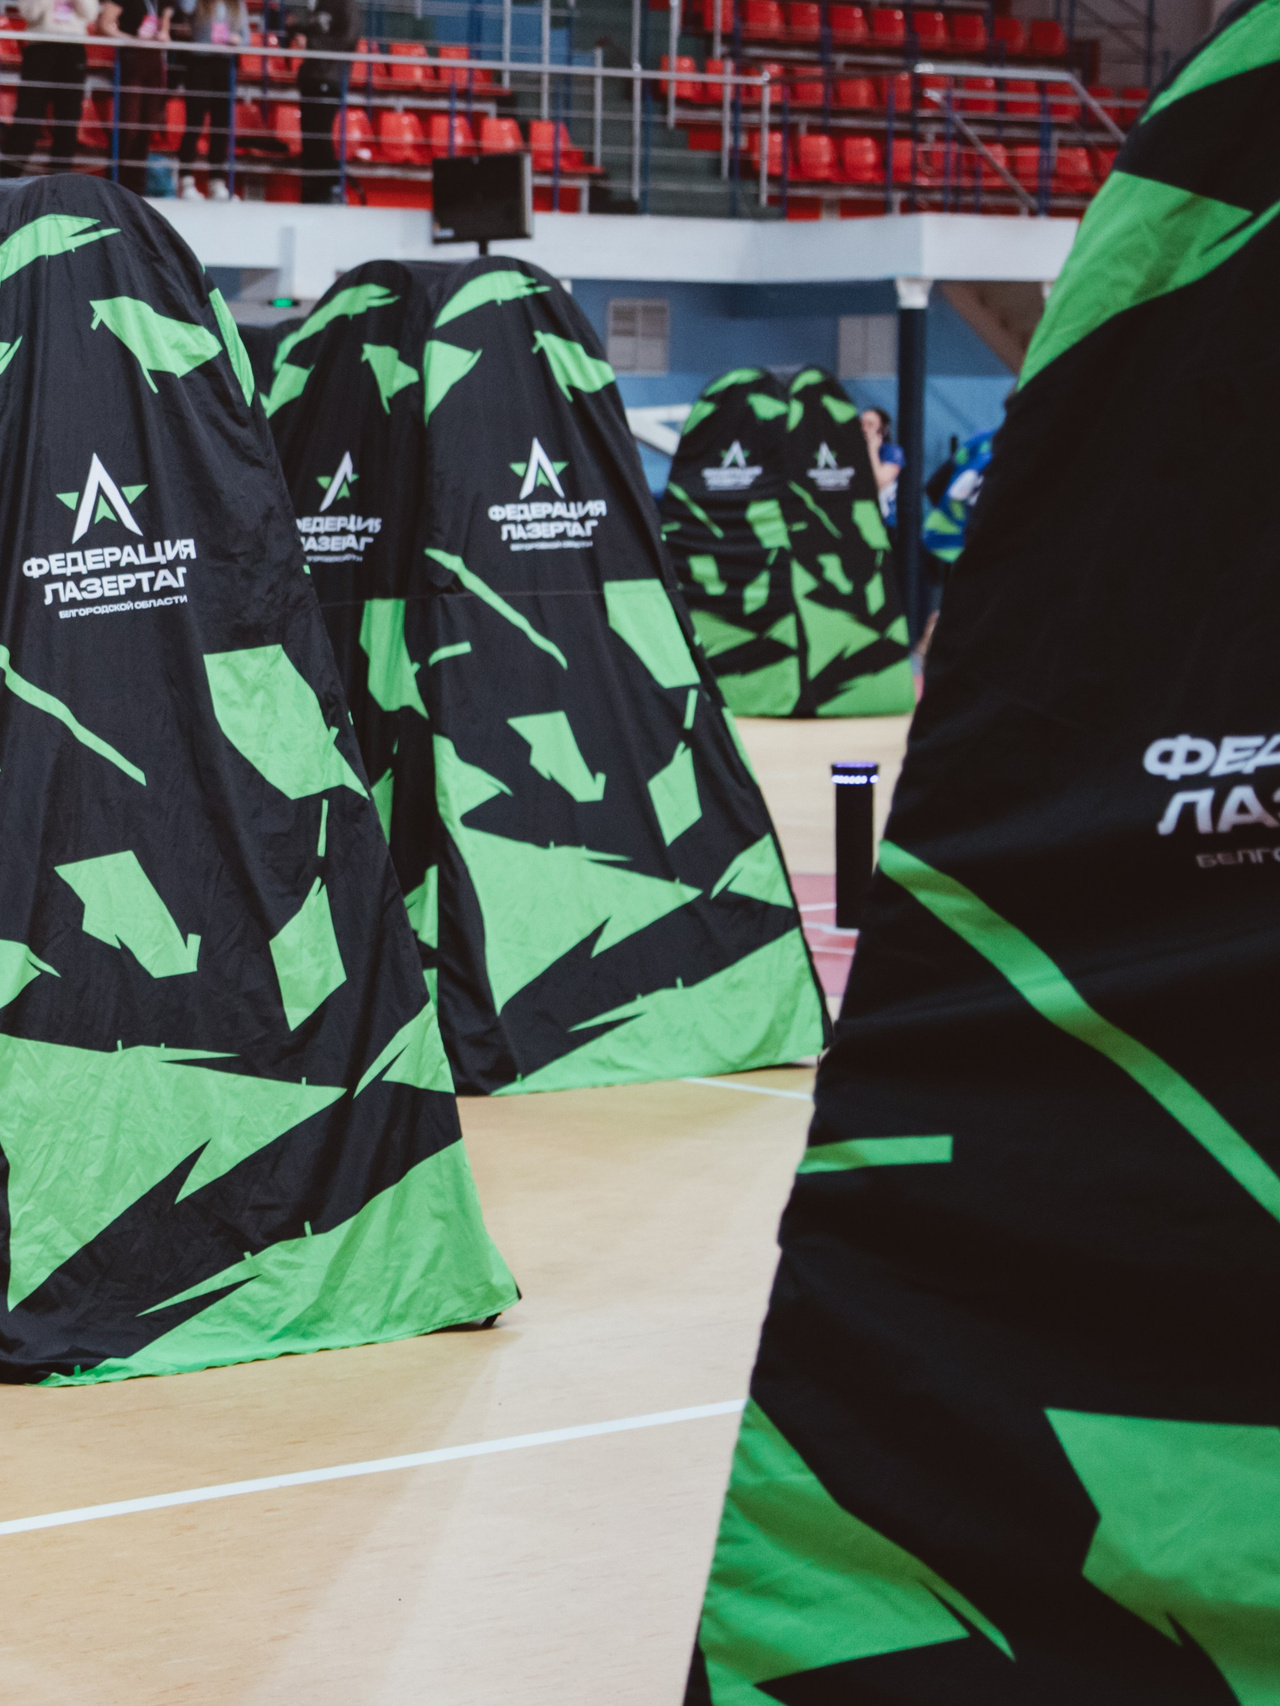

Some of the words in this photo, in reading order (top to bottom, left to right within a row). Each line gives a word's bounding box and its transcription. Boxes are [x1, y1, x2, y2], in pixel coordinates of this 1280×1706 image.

[488, 500, 607, 522] ФЕДЕРАЦИЯ
[501, 519, 599, 541] ЛАЗЕРТАГ
[22, 538, 197, 579] ФЕДЕРАЦИЯ
[44, 566, 187, 606] ЛАЗЕРТАГ
[1157, 785, 1280, 835] ЛА
